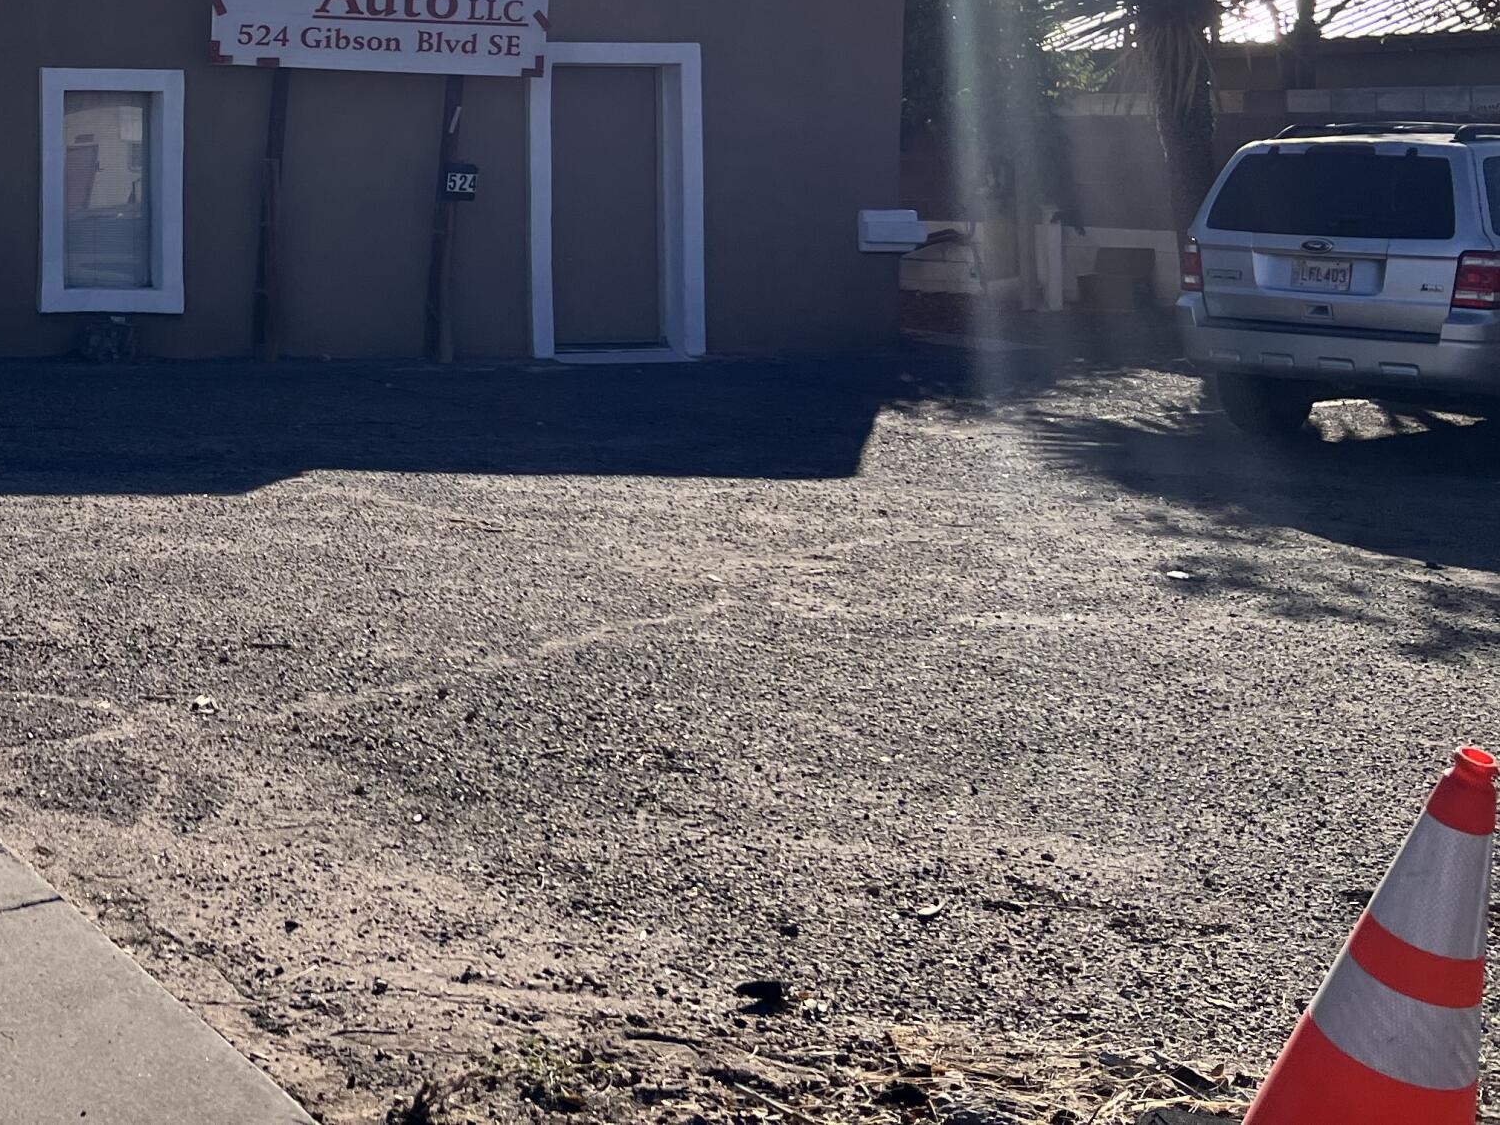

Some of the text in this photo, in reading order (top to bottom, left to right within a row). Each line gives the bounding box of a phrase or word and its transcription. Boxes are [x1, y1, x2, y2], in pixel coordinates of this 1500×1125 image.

[237, 23, 522, 57] 524 Gibson Blvd SE
[448, 174, 476, 191] 524
